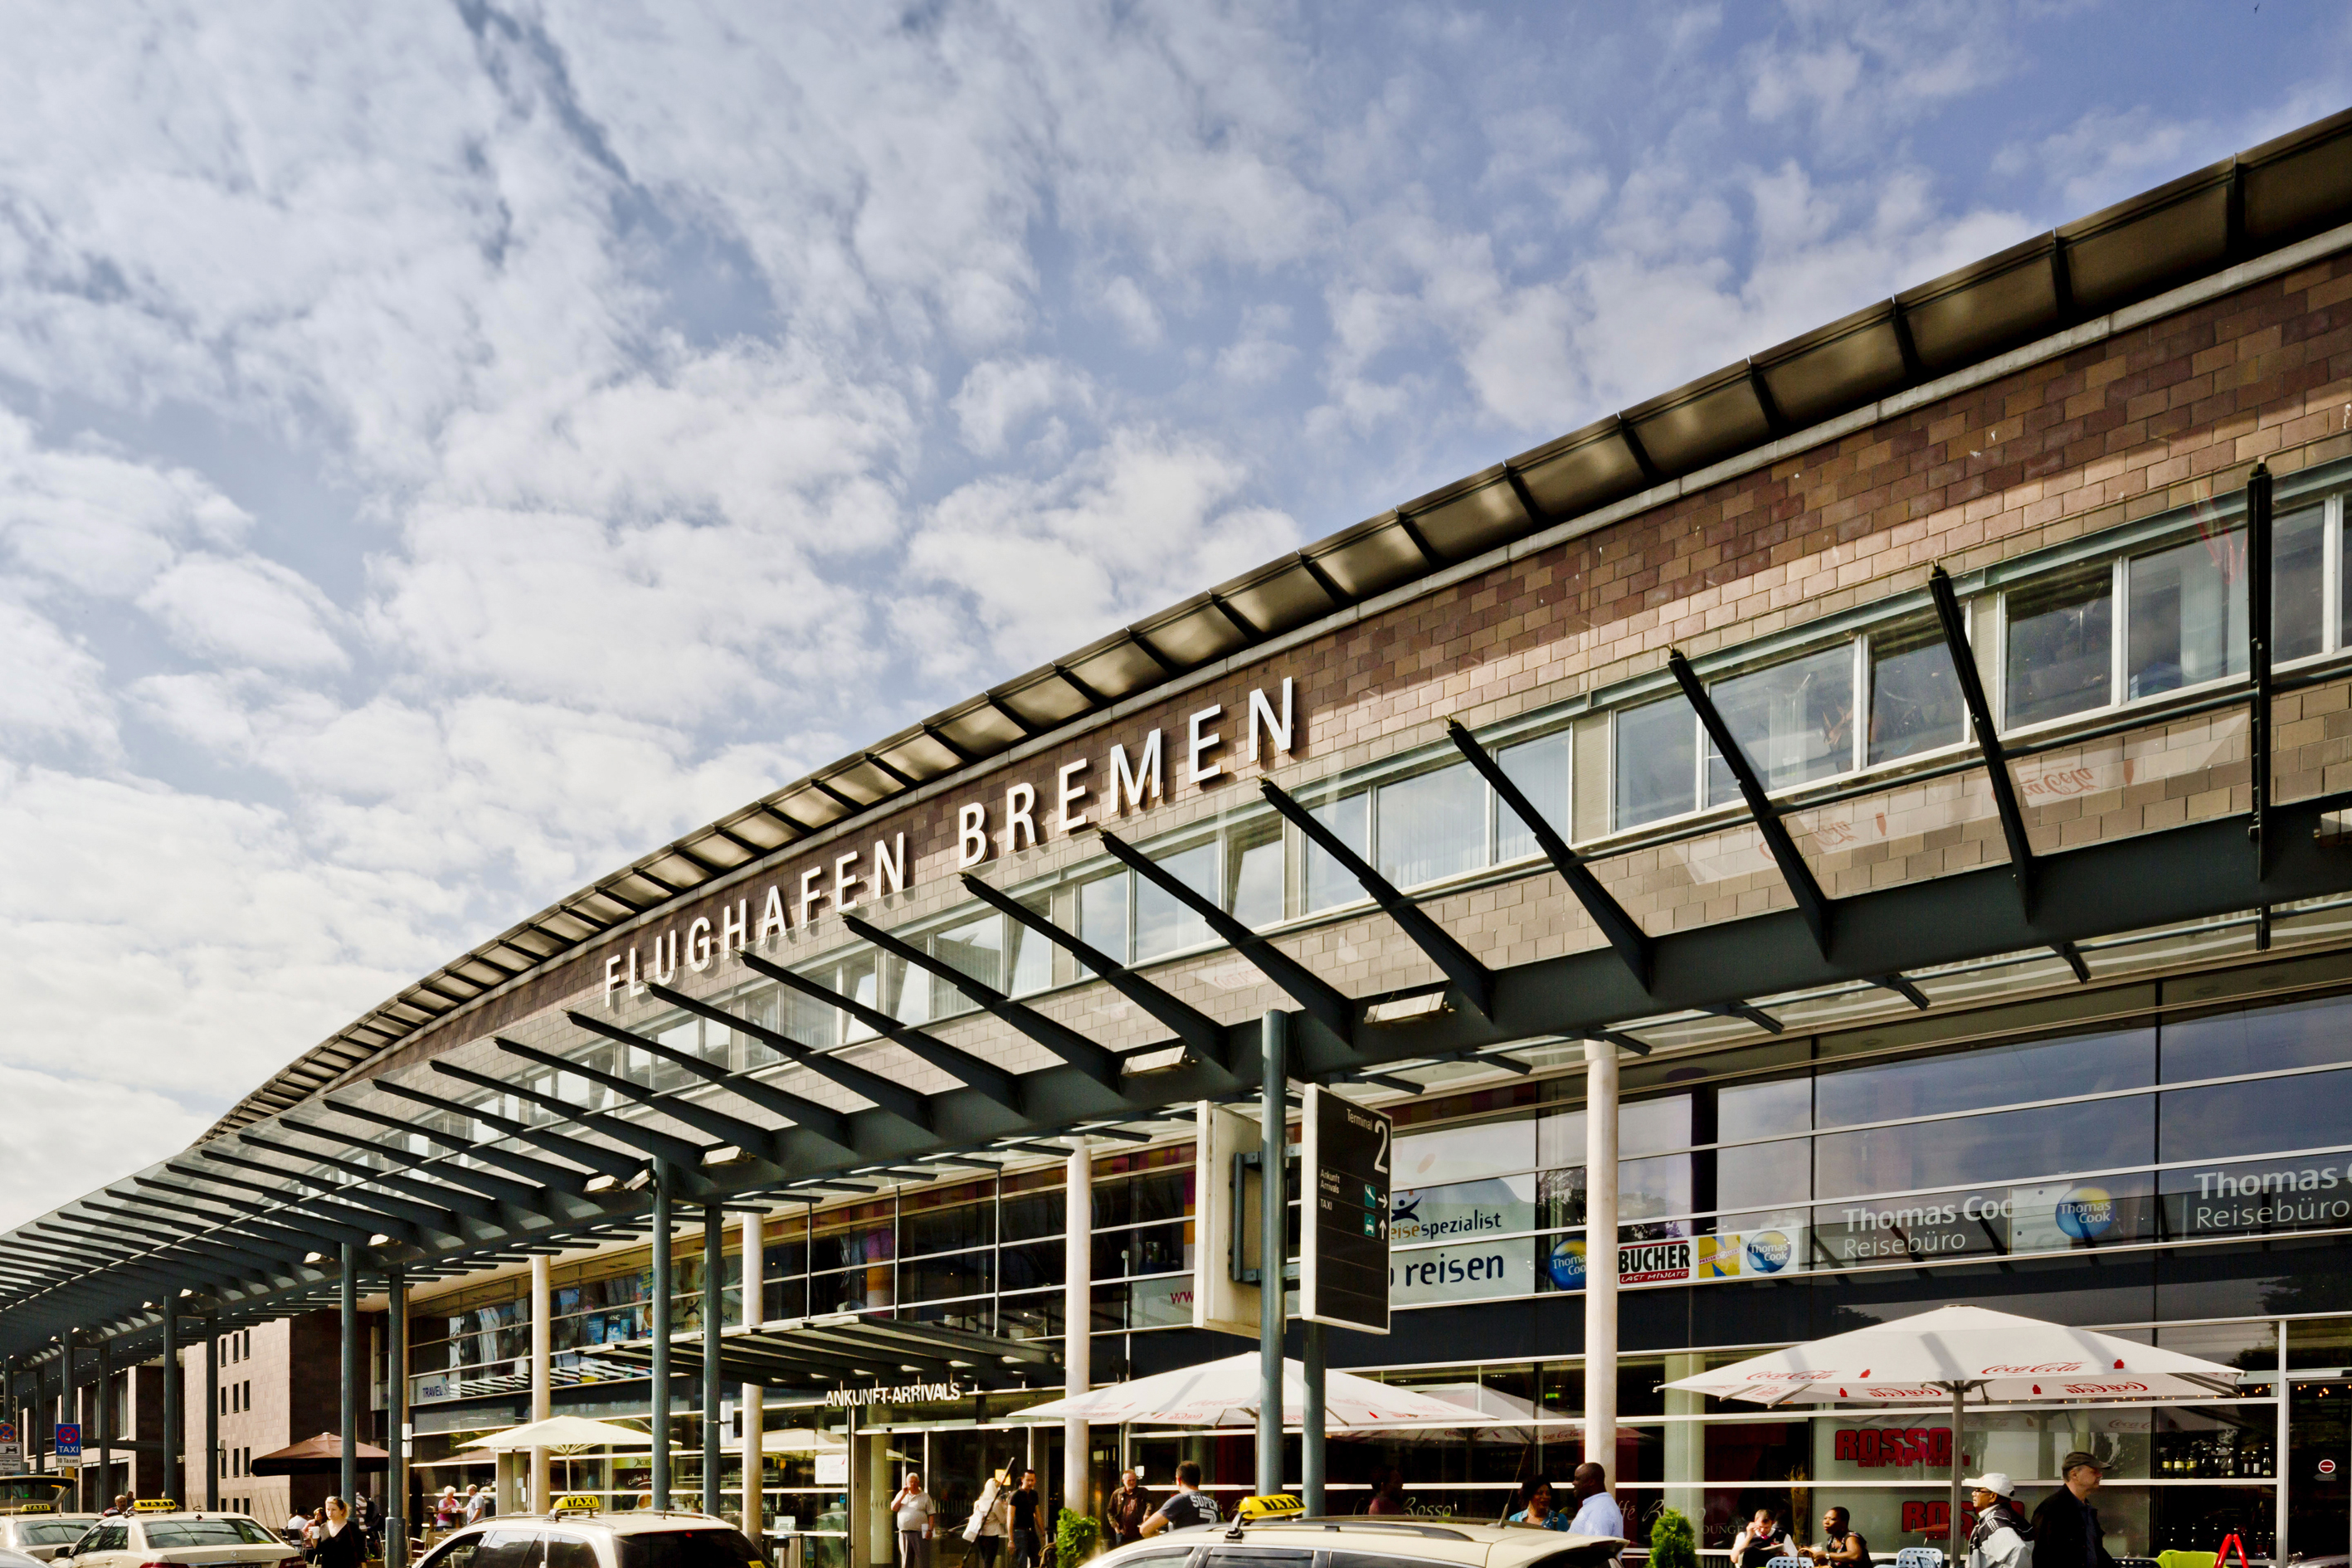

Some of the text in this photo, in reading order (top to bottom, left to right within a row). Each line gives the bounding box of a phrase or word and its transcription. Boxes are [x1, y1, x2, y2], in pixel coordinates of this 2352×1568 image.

[605, 676, 1293, 1008] FLUGHAFEN BREMEN
[1346, 1108, 1389, 1175] Terminal 2
[1320, 1168, 1341, 1184] Ankunft
[2194, 1166, 2339, 1200] Thomas
[1320, 1179, 1340, 1195] Arrivals
[1320, 1198, 1332, 1211] TAXI
[2059, 1201, 2111, 1215] Thomas
[1842, 1195, 2014, 1233] Thomas Coo
[2078, 1210, 2111, 1225] Cook
[2196, 1197, 2350, 1230] Reisebüro
[1390, 1208, 1502, 1240] eisespezialist
[1750, 1244, 1789, 1254] Thomas
[1843, 1230, 1966, 1259] Reisebüro
[1552, 1254, 1587, 1270] Thoma
[1618, 1244, 1691, 1274] BUCHER
[1764, 1251, 1788, 1262] Cook
[1405, 1253, 1504, 1288] reisen
[1567, 1264, 1587, 1276] Coo
[1620, 1270, 1689, 1283] LAST MINUTE
[1981, 1360, 2089, 1375] Coca-Cola
[1746, 1370, 1839, 1381] Coca-Cola
[422, 1385, 443, 1398] TRAVEL
[825, 1382, 961, 1407] ANKUNFT-ARRIVALS
[58, 1445, 79, 1454] TAXI
[1834, 1427, 1953, 1461] ROSSO
[567, 1497, 596, 1507] TAXI
[1265, 1497, 1302, 1509] TAXI
[1702, 1525, 1742, 1535] OUNGE
